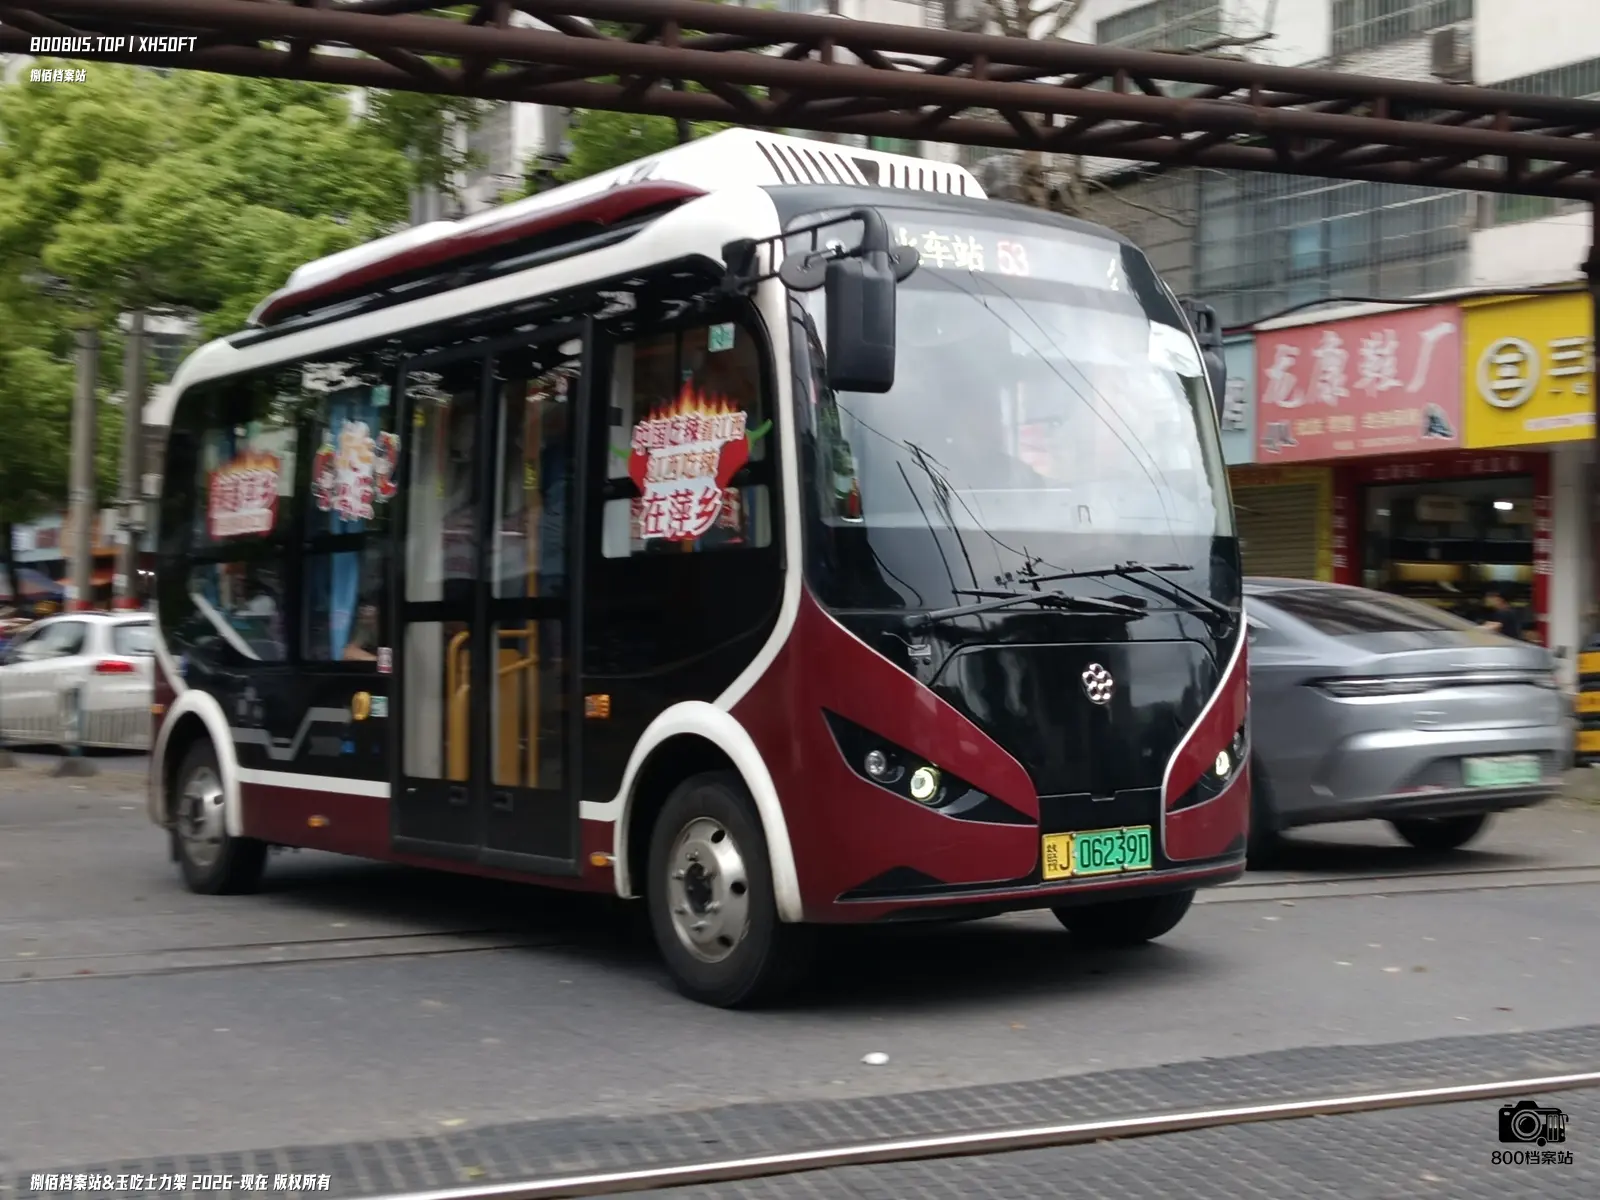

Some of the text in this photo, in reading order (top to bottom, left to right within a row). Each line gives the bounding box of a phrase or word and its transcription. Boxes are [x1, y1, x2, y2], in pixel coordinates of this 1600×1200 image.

[642, 487, 722, 539] 在萍乡
[1079, 833, 1150, 869] 06239D
